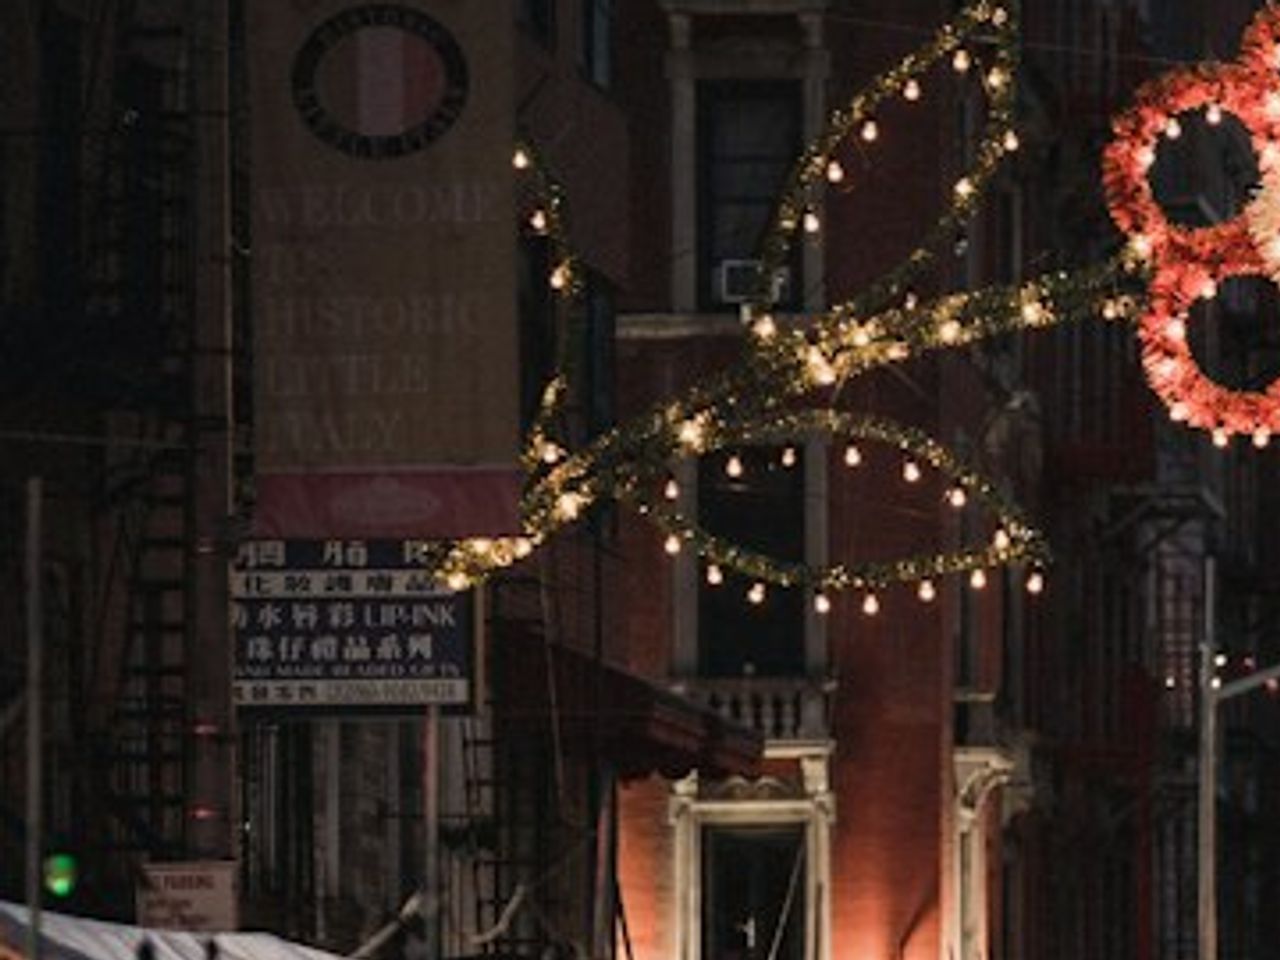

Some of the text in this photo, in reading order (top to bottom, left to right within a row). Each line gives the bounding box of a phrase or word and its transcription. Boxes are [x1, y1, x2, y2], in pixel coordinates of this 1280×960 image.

[258, 183, 500, 224] WELCOME
[264, 294, 486, 337] HISTORIC
[265, 354, 429, 396] LITTLE
[266, 411, 402, 453] ITALY
